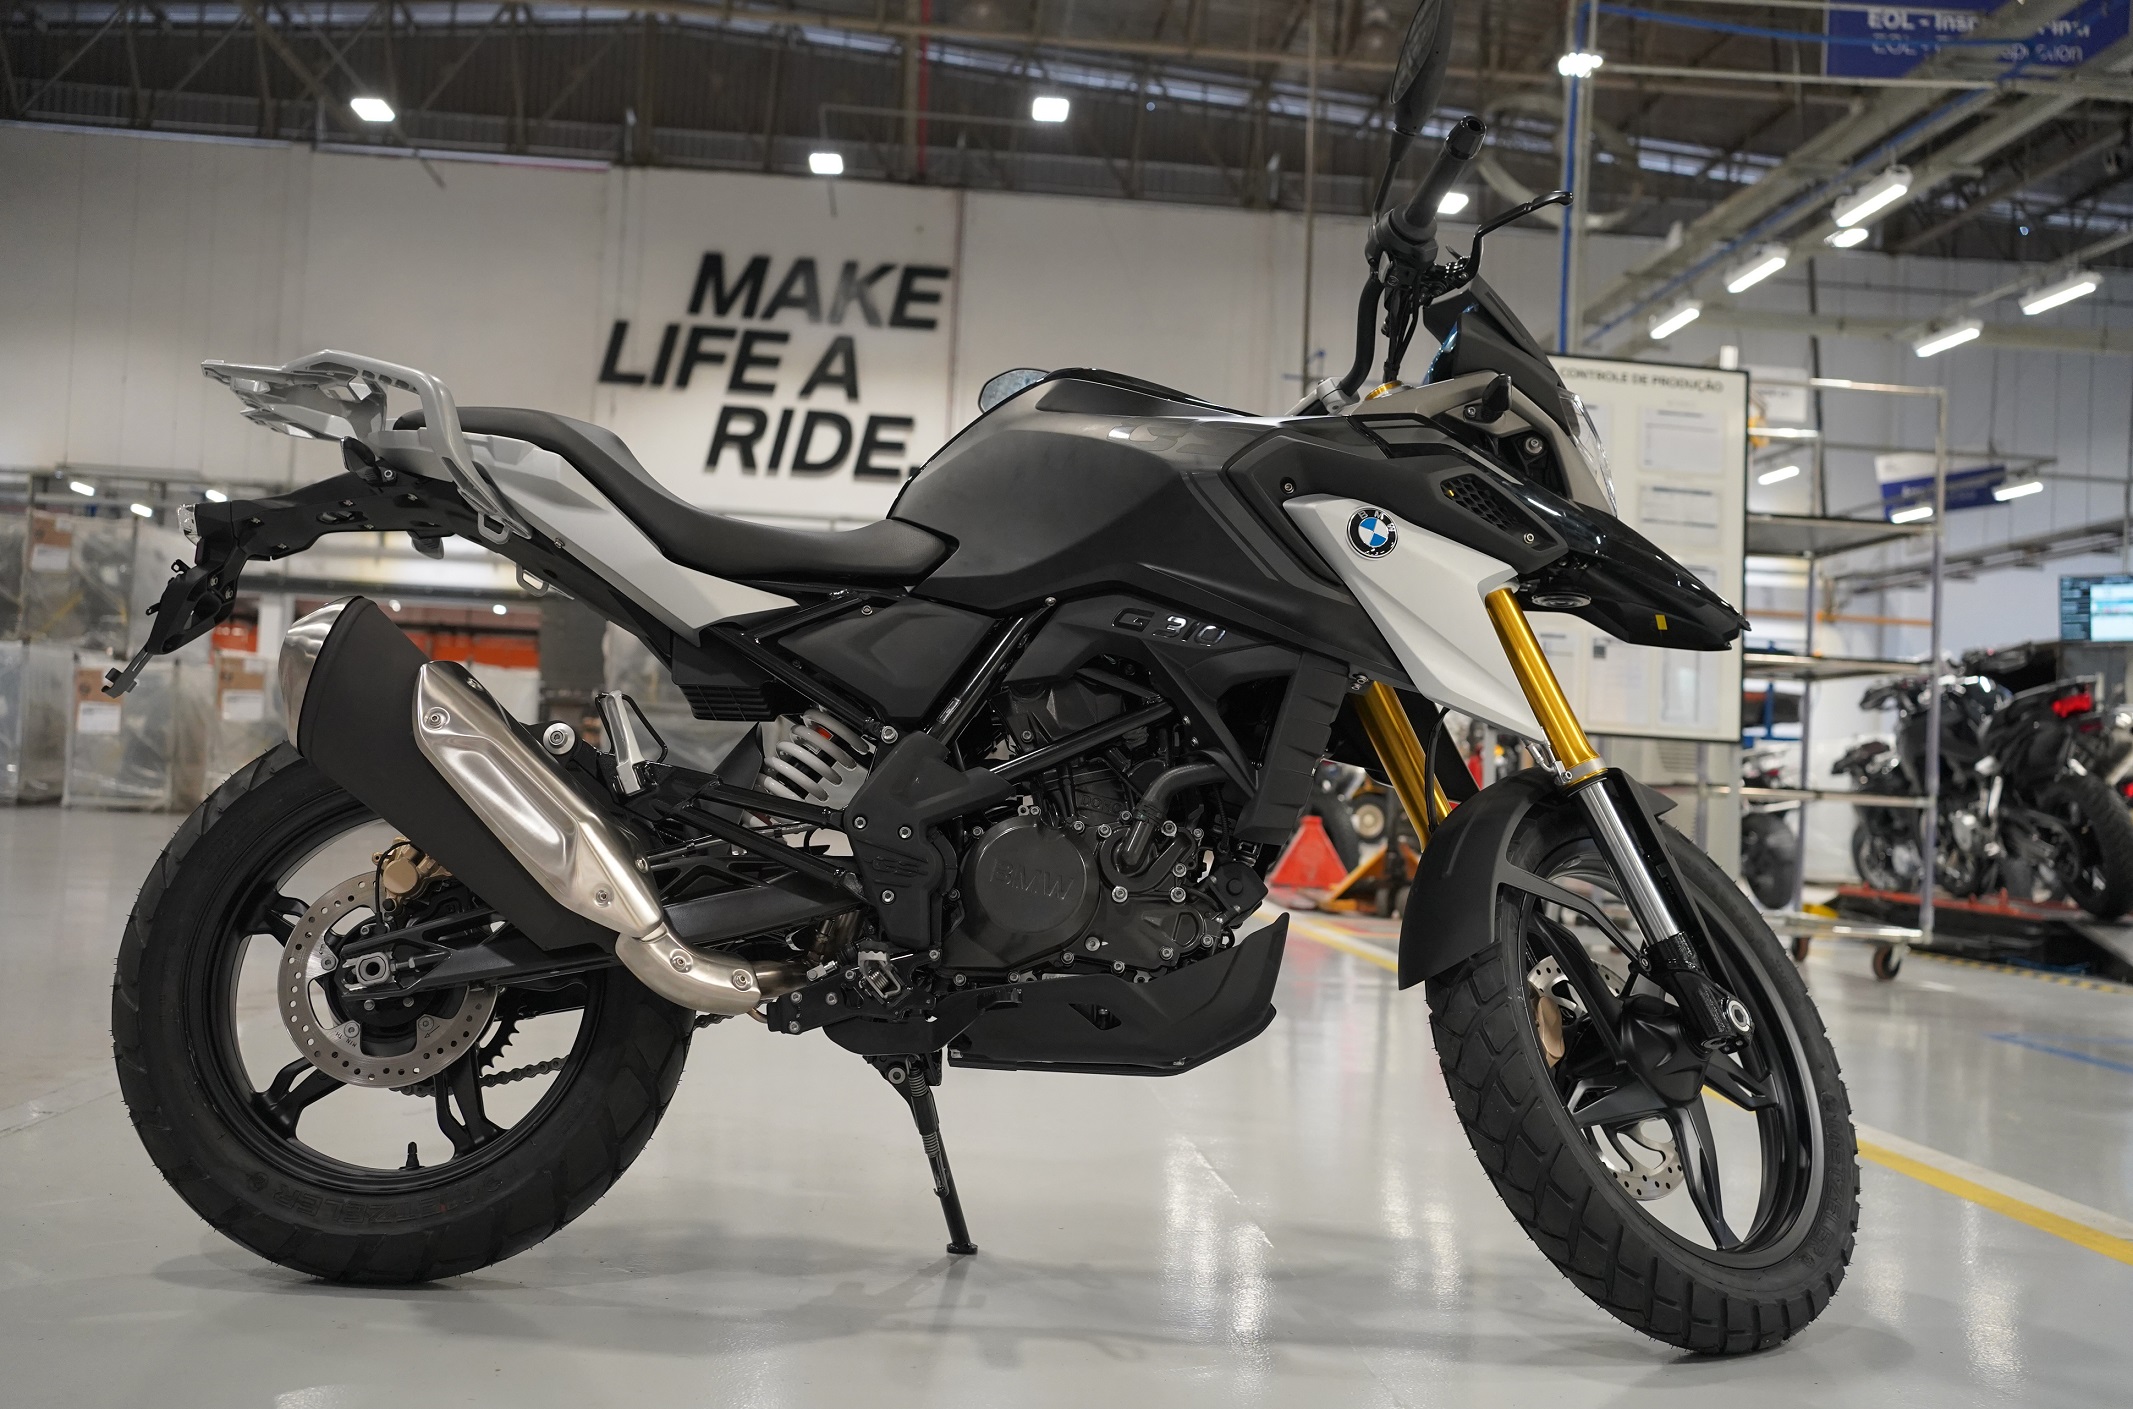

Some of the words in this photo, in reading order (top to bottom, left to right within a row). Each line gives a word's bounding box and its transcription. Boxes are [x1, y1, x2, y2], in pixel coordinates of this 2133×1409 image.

[687, 250, 950, 330] MAKE
[599, 318, 790, 396] LIFE
[798, 334, 860, 401] A
[1560, 366, 1627, 384] CONTROLE
[1632, 373, 1649, 385] DE
[1651, 375, 1725, 393] PRODUÇÃO
[1357, 510, 1396, 532] BMW
[1111, 607, 1156, 633] G
[1152, 615, 1226, 647] 310
[989, 858, 1075, 900] BMW
